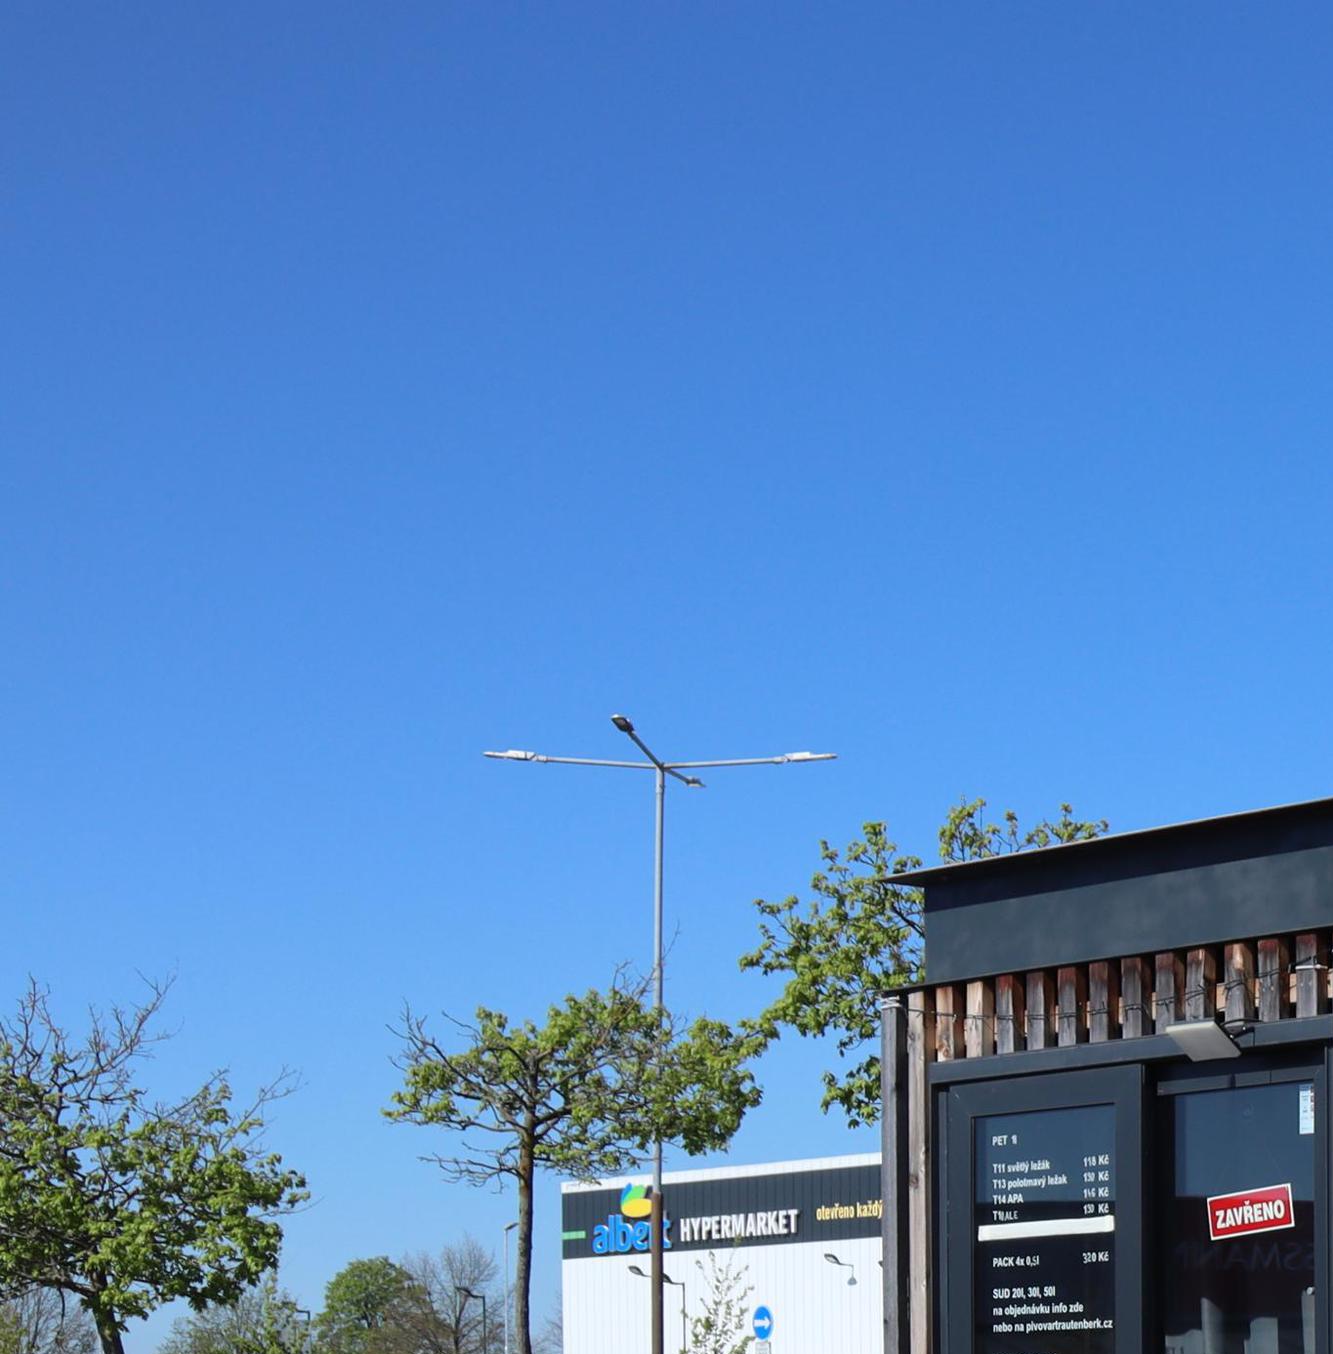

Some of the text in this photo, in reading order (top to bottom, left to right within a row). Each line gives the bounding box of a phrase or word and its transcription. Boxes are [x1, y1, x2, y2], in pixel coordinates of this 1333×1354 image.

[992, 1135, 1008, 1146] PET
[1098, 1154, 1109, 1165] Kč
[1098, 1171, 1109, 1181] Kč
[1007, 1193, 1024, 1204] APA
[1098, 1187, 1109, 1198] Kč
[816, 1202, 855, 1221] otevřeno
[1098, 1203, 1109, 1214] Kč
[1215, 1199, 1285, 1229] ZAVŘENO
[592, 1209, 798, 1254] albet HYPERMARKET
[993, 1257, 1014, 1268] PACK
[1015, 1257, 1025, 1266] 4x
[1098, 1251, 1109, 1262] Kč
[993, 1288, 1010, 1299] SUD
[993, 1302, 1084, 1317] na objednávku info zde
[993, 1318, 1113, 1333] nebo na pivovartrautenberk.cz
